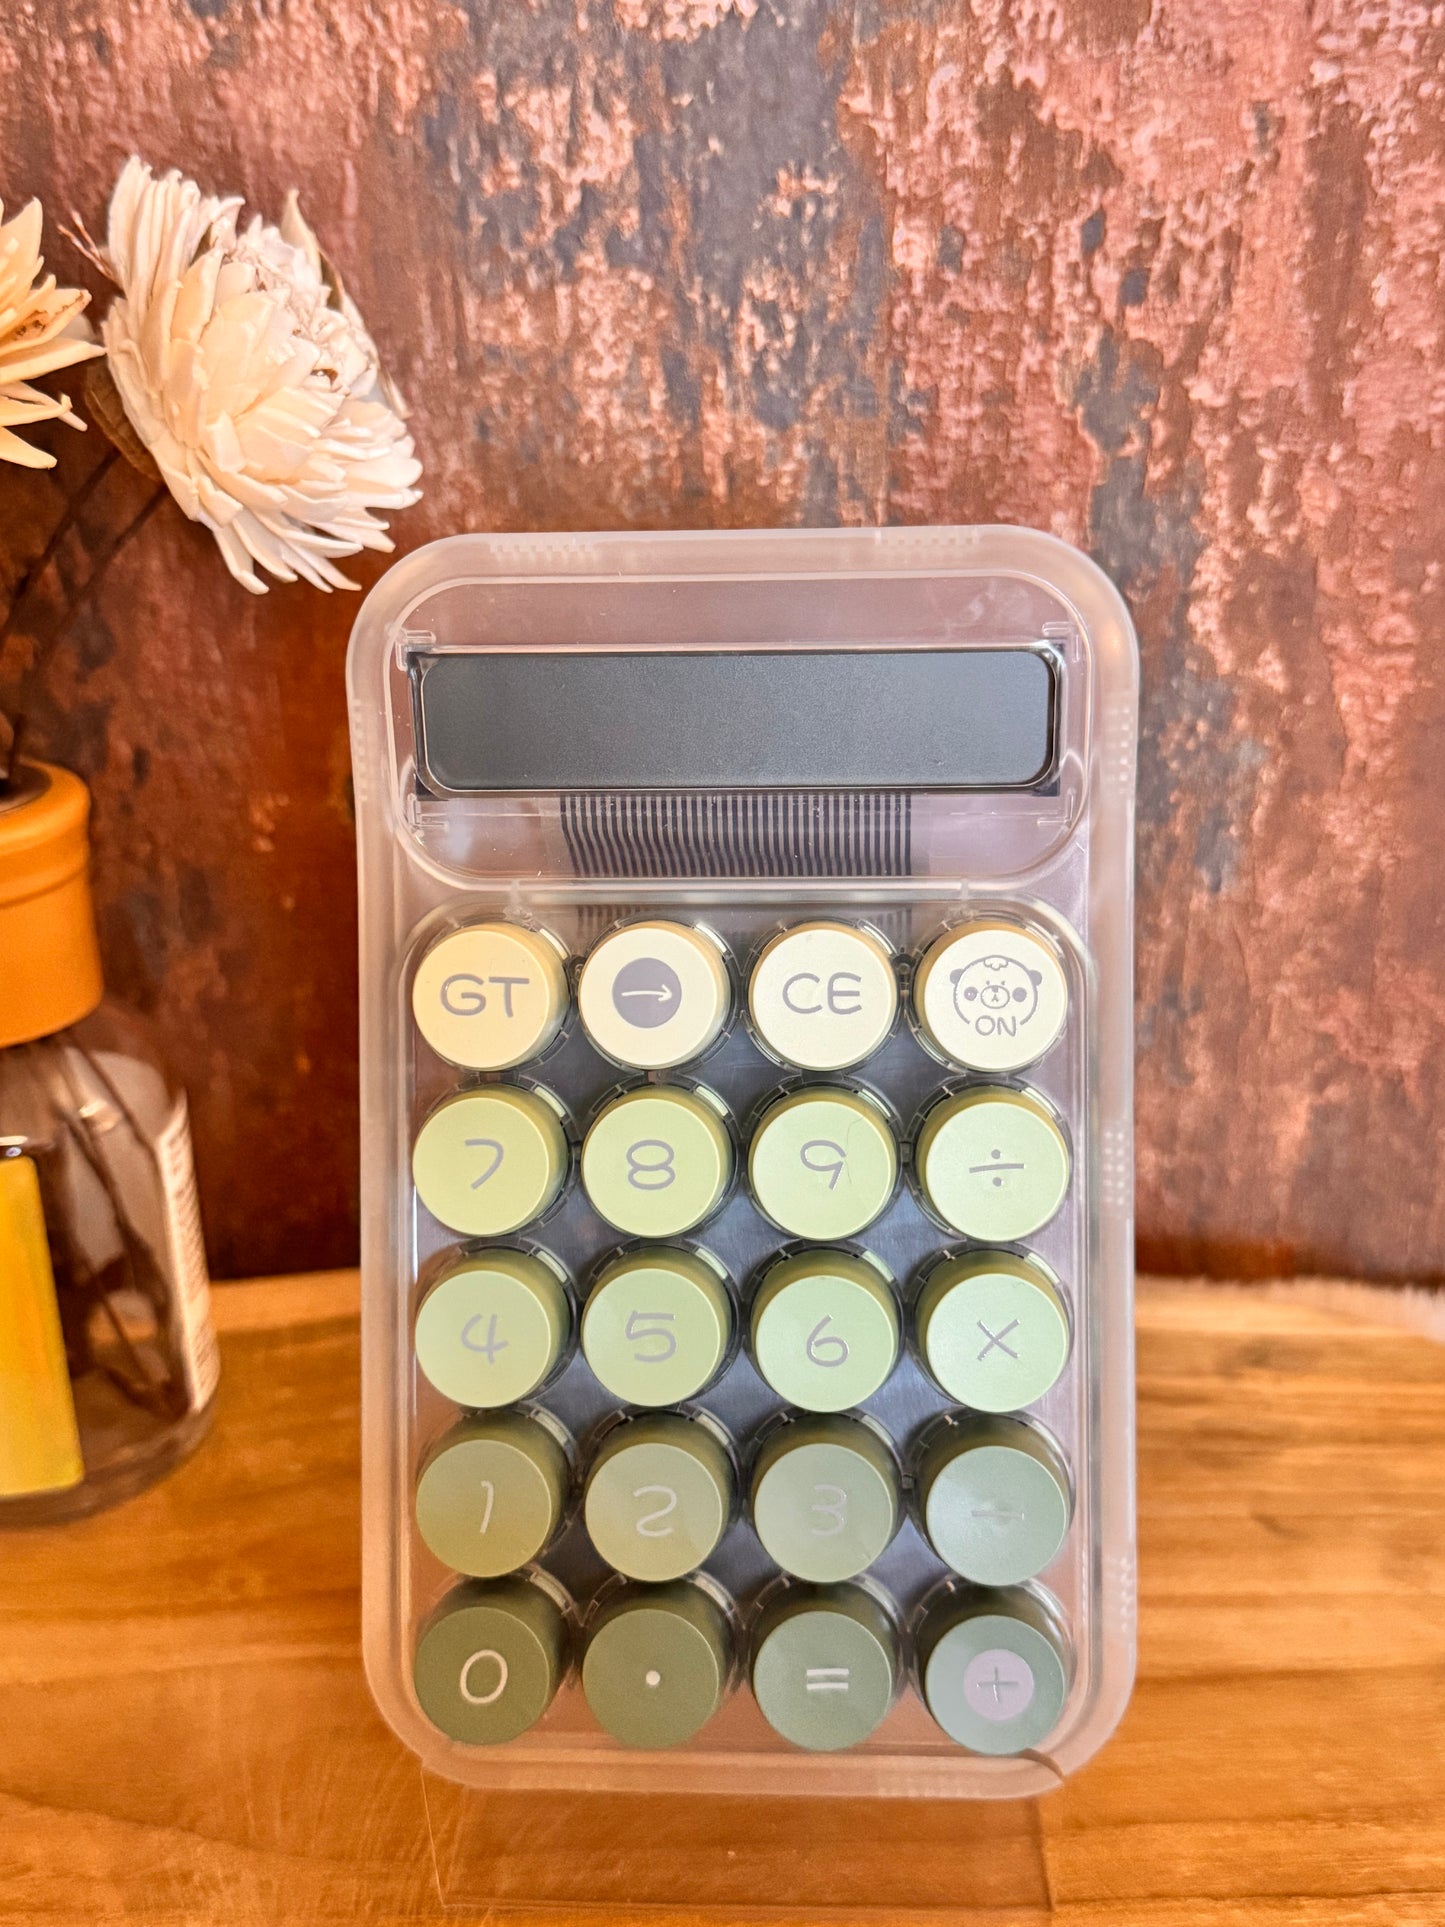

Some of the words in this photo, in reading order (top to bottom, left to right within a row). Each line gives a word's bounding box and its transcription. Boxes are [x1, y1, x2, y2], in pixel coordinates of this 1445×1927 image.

[440, 973, 530, 1018] GT
[782, 972, 863, 1015] CE
[974, 1015, 1018, 1038] ON
[465, 1138, 504, 1190] 7
[626, 1140, 676, 1191] 8
[800, 1139, 847, 1191] 9
[460, 1312, 509, 1365] 4
[625, 1310, 677, 1363] 5
[806, 1315, 849, 1368] 6
[480, 1480, 495, 1534] 1
[633, 1484, 677, 1538] 2
[811, 1484, 848, 1537] 3
[459, 1649, 508, 1704] 0
